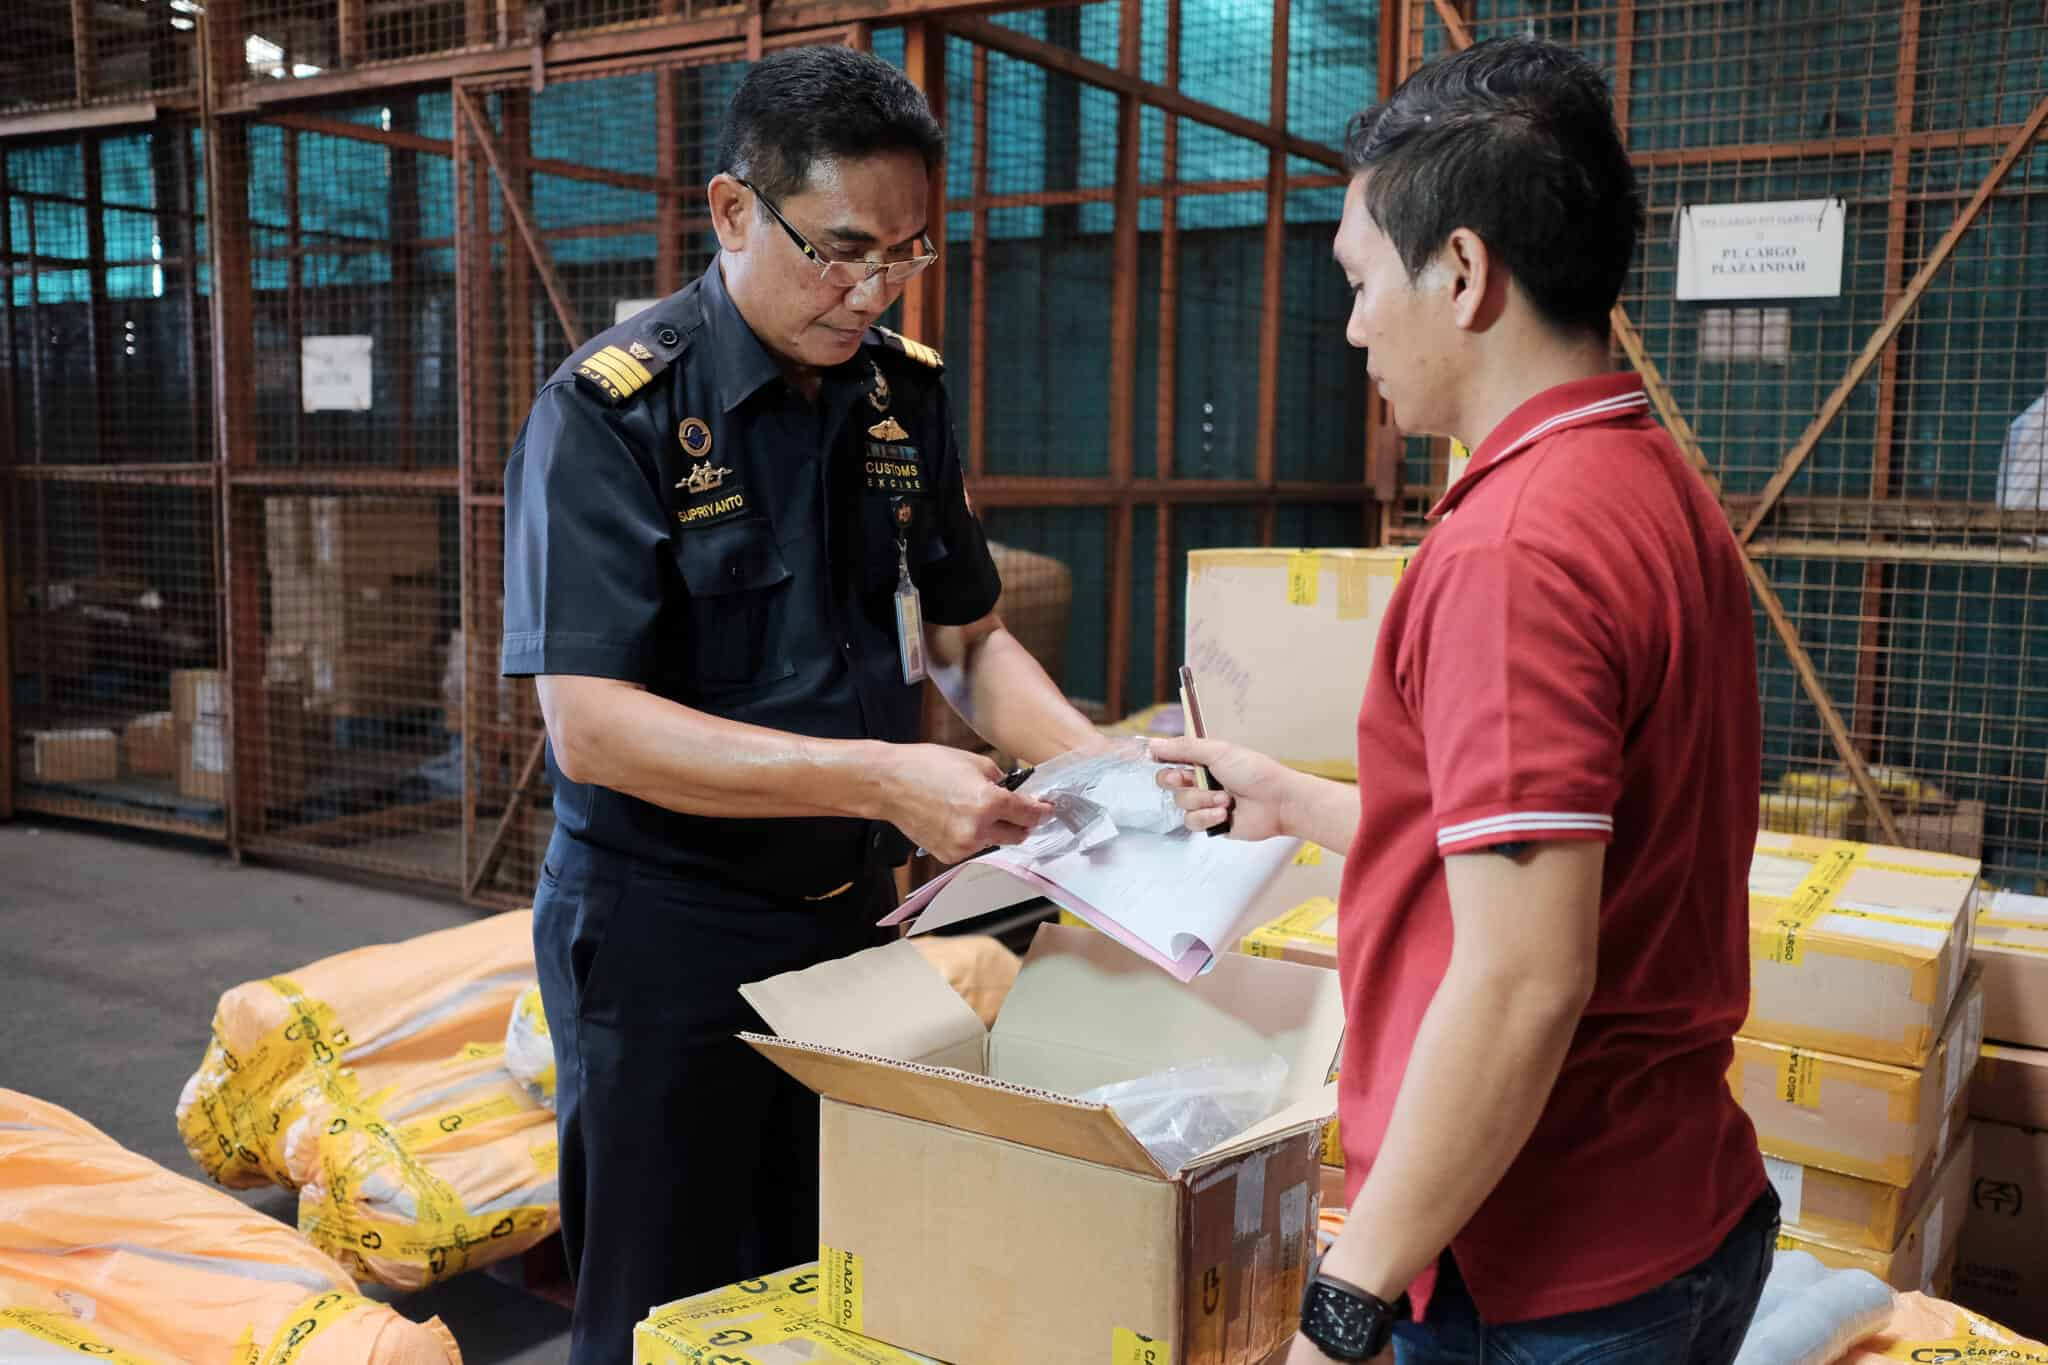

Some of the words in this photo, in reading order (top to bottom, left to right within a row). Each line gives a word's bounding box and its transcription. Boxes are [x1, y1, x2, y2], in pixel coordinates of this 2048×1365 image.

[865, 461, 918, 477] CUSTOMS
[867, 478, 921, 489] EXCISE
[678, 494, 743, 523] SUPRIYANTO
[843, 1250, 854, 1295] PLAZA
